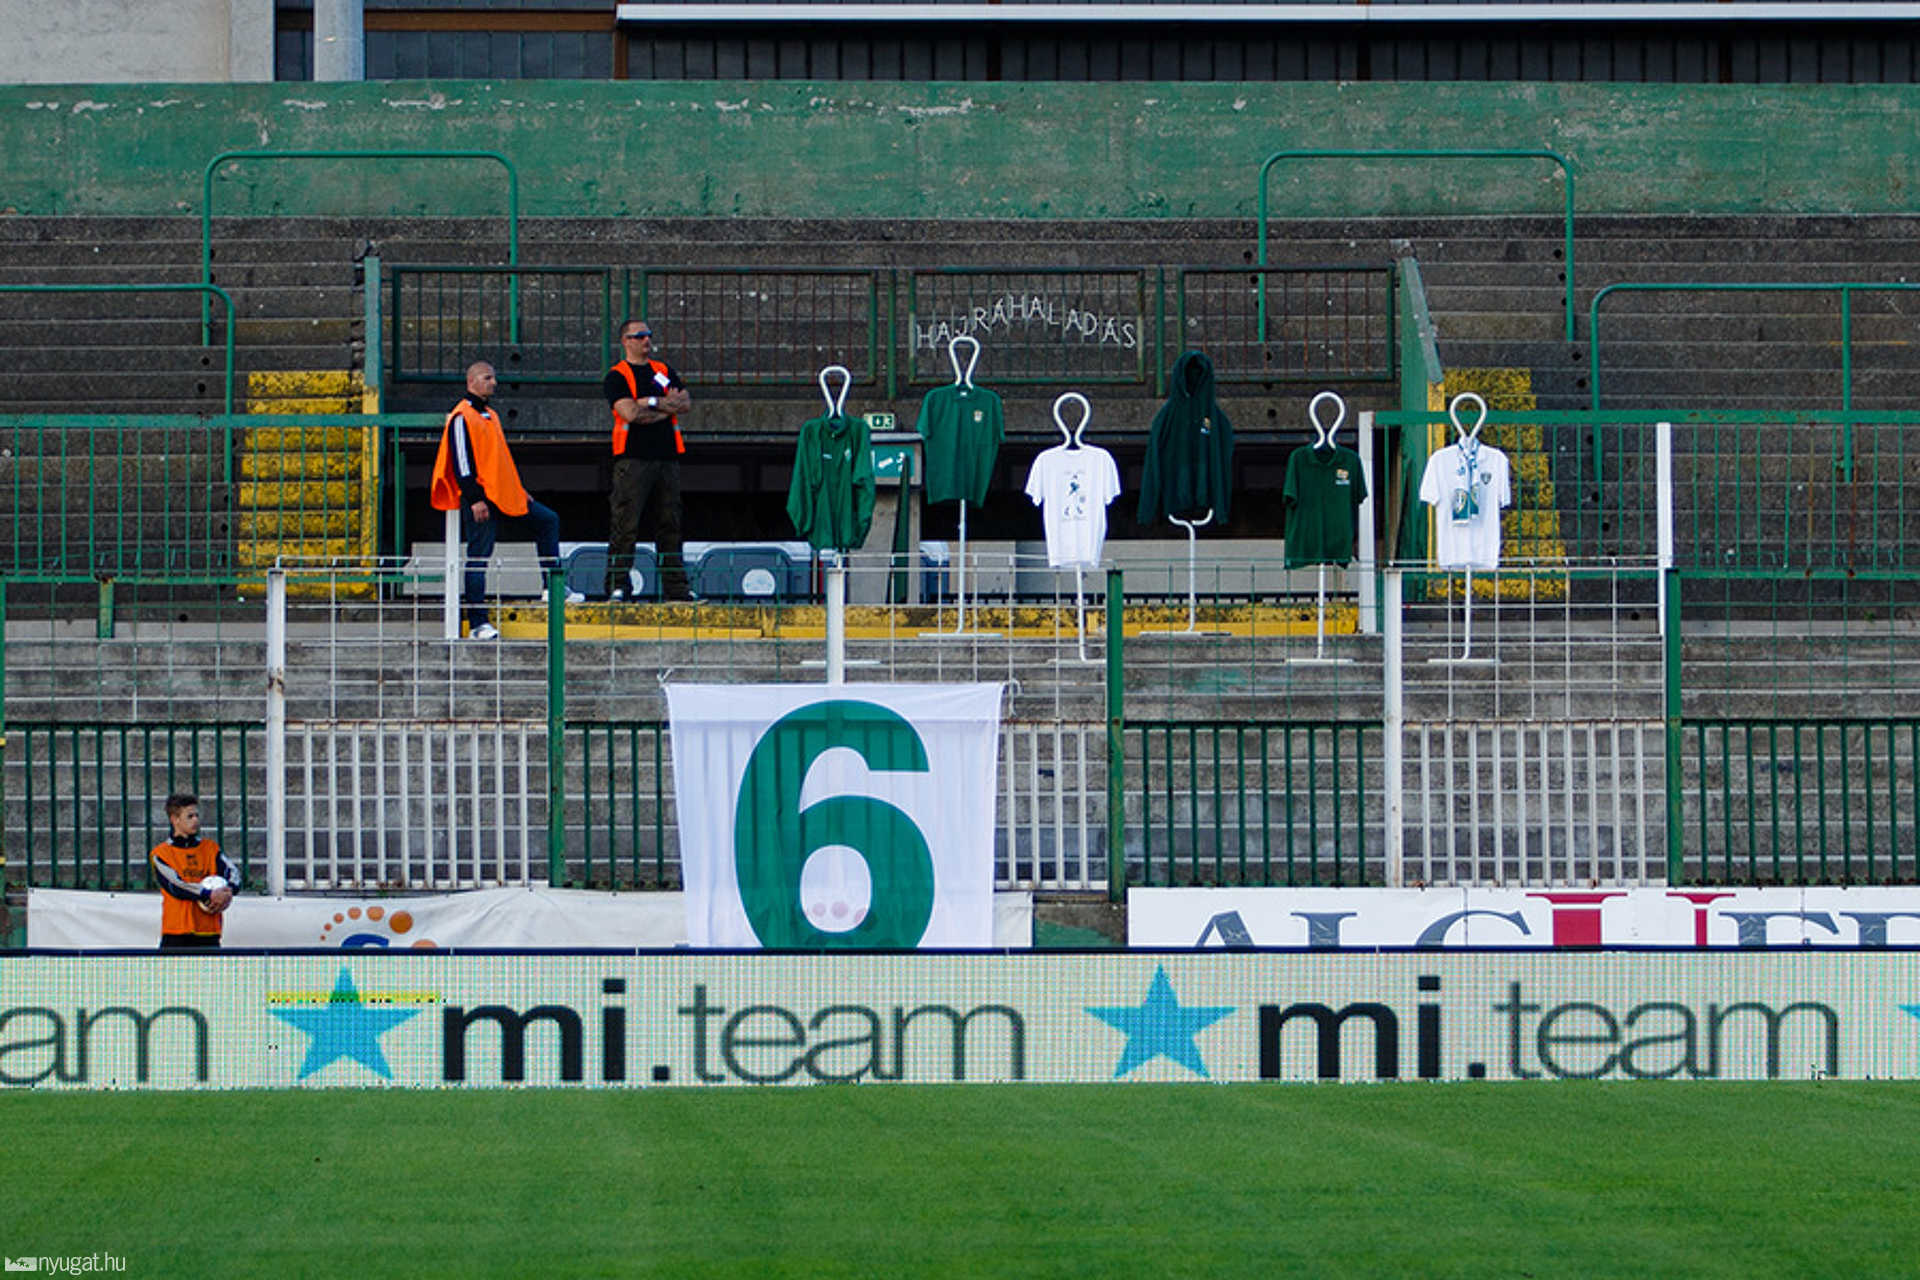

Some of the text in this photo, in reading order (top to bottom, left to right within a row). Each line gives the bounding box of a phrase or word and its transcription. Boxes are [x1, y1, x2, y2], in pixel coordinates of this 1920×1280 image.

[734, 699, 935, 948] 6
[443, 978, 1024, 1083] mi.team
[1259, 976, 1838, 1079] mi.team
